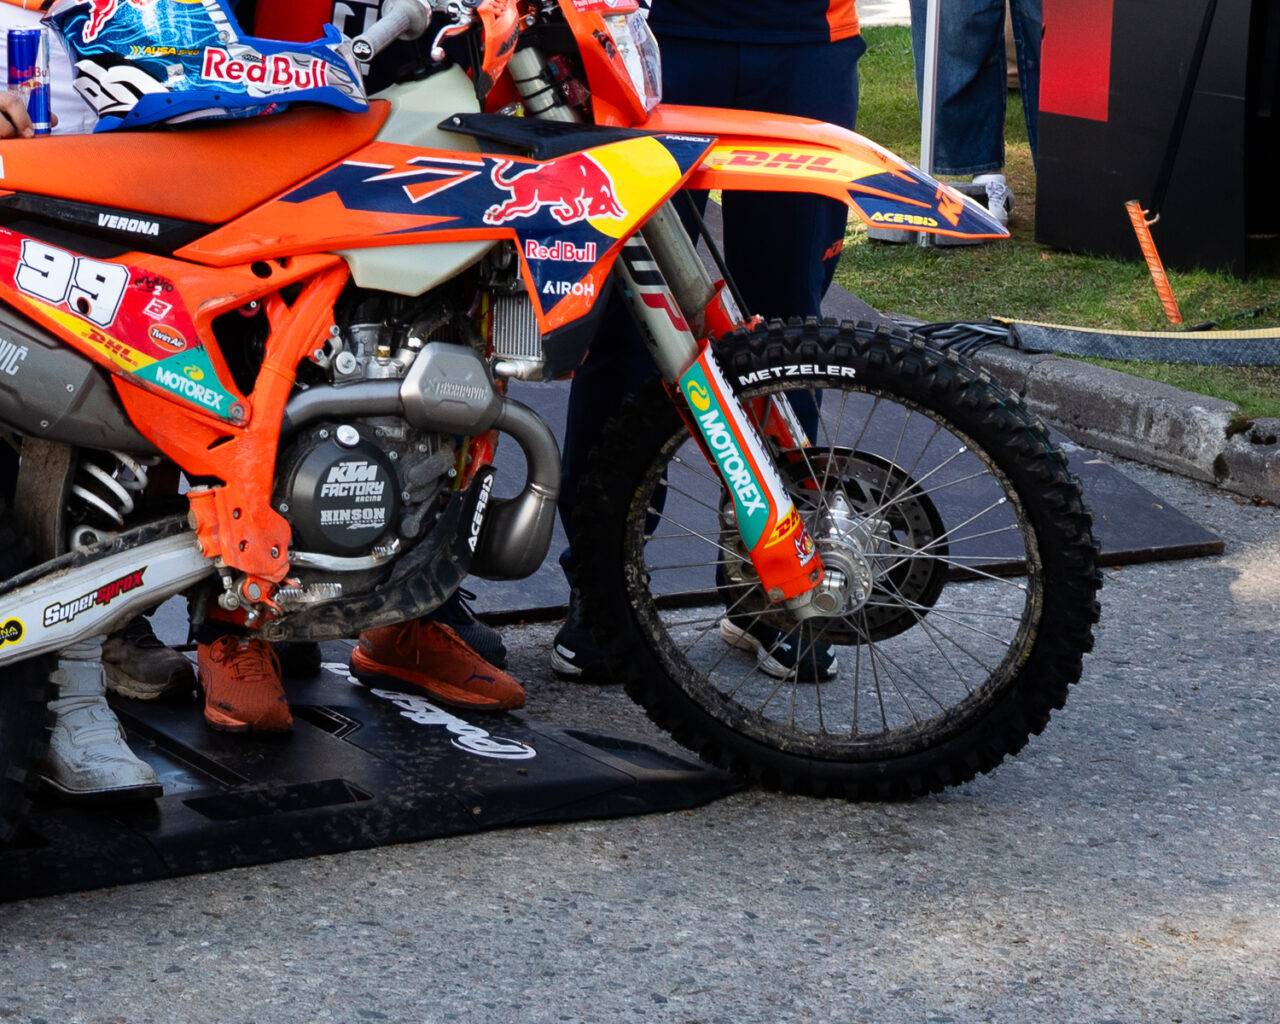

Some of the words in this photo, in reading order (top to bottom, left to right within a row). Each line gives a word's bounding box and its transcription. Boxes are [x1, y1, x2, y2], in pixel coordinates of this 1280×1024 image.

[204, 50, 267, 83] Red
[273, 56, 327, 88] Bull
[727, 150, 838, 173] DHL
[98, 214, 159, 236] VERONA
[870, 212, 939, 227] ACERBIS
[526, 240, 562, 261] Red
[563, 241, 596, 262] Bull
[14, 239, 131, 329] 99
[542, 281, 594, 297] AIROH
[88, 329, 133, 364] DHL
[152, 328, 171, 343] Twin
[169, 337, 184, 348] Air
[738, 364, 856, 387] METZELER
[156, 367, 224, 409] MOTOREX
[327, 461, 378, 483] KTM
[700, 410, 767, 518] MOTOREX
[320, 481, 385, 498] FACTORY
[355, 495, 382, 503] RACING
[320, 507, 386, 522] HINSON
[468, 474, 494, 553] ACERBIS
[44, 568, 145, 627] Supersprox
